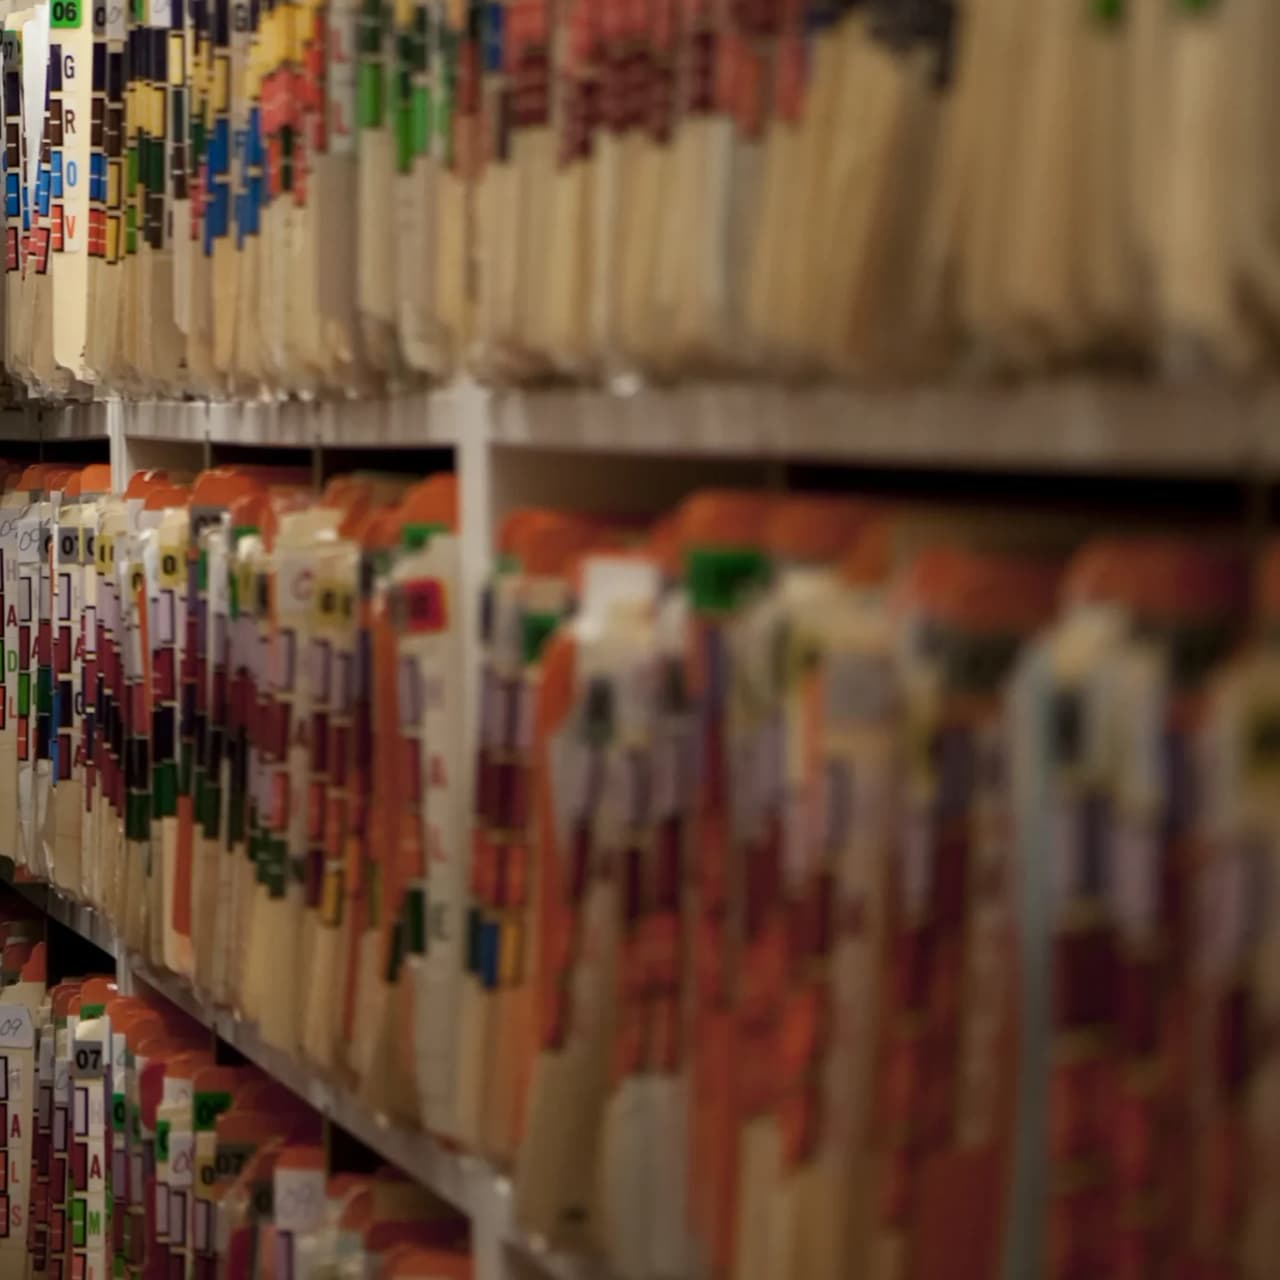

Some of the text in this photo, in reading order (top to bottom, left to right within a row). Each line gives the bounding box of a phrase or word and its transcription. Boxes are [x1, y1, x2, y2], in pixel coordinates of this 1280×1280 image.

[52, 1, 77, 21] 06
[0, 1017, 23, 1037] 09
[75, 1048, 101, 1070] 07
